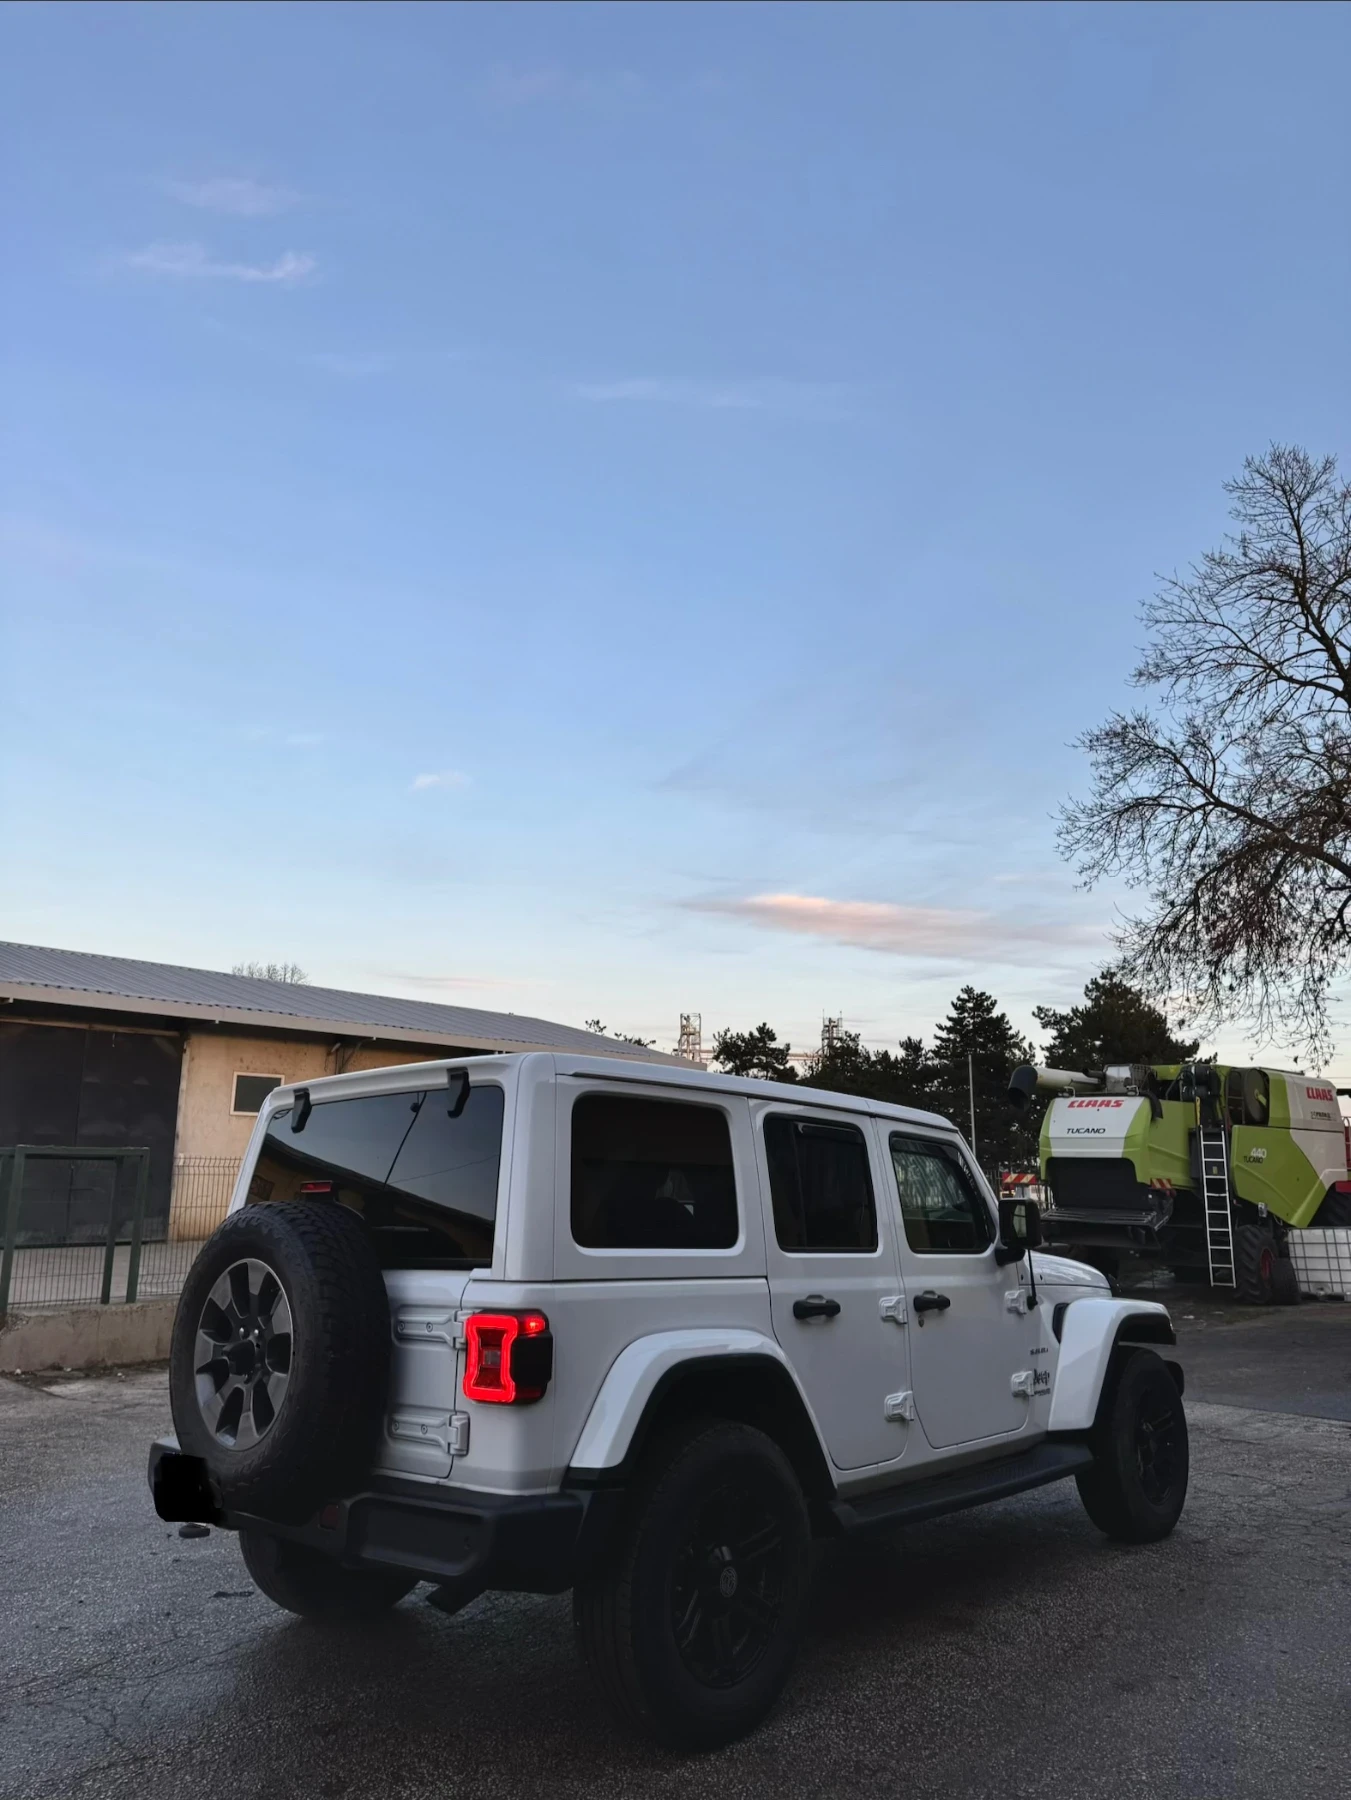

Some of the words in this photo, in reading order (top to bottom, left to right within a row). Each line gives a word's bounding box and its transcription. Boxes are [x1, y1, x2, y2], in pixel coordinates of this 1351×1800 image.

[1305, 1086, 1334, 1101] CLAAS
[1067, 1099, 1124, 1108] CLAAS
[1066, 1127, 1106, 1135] TUCANO
[1250, 1147, 1267, 1158] 440
[1243, 1155, 1264, 1164] TUCANO
